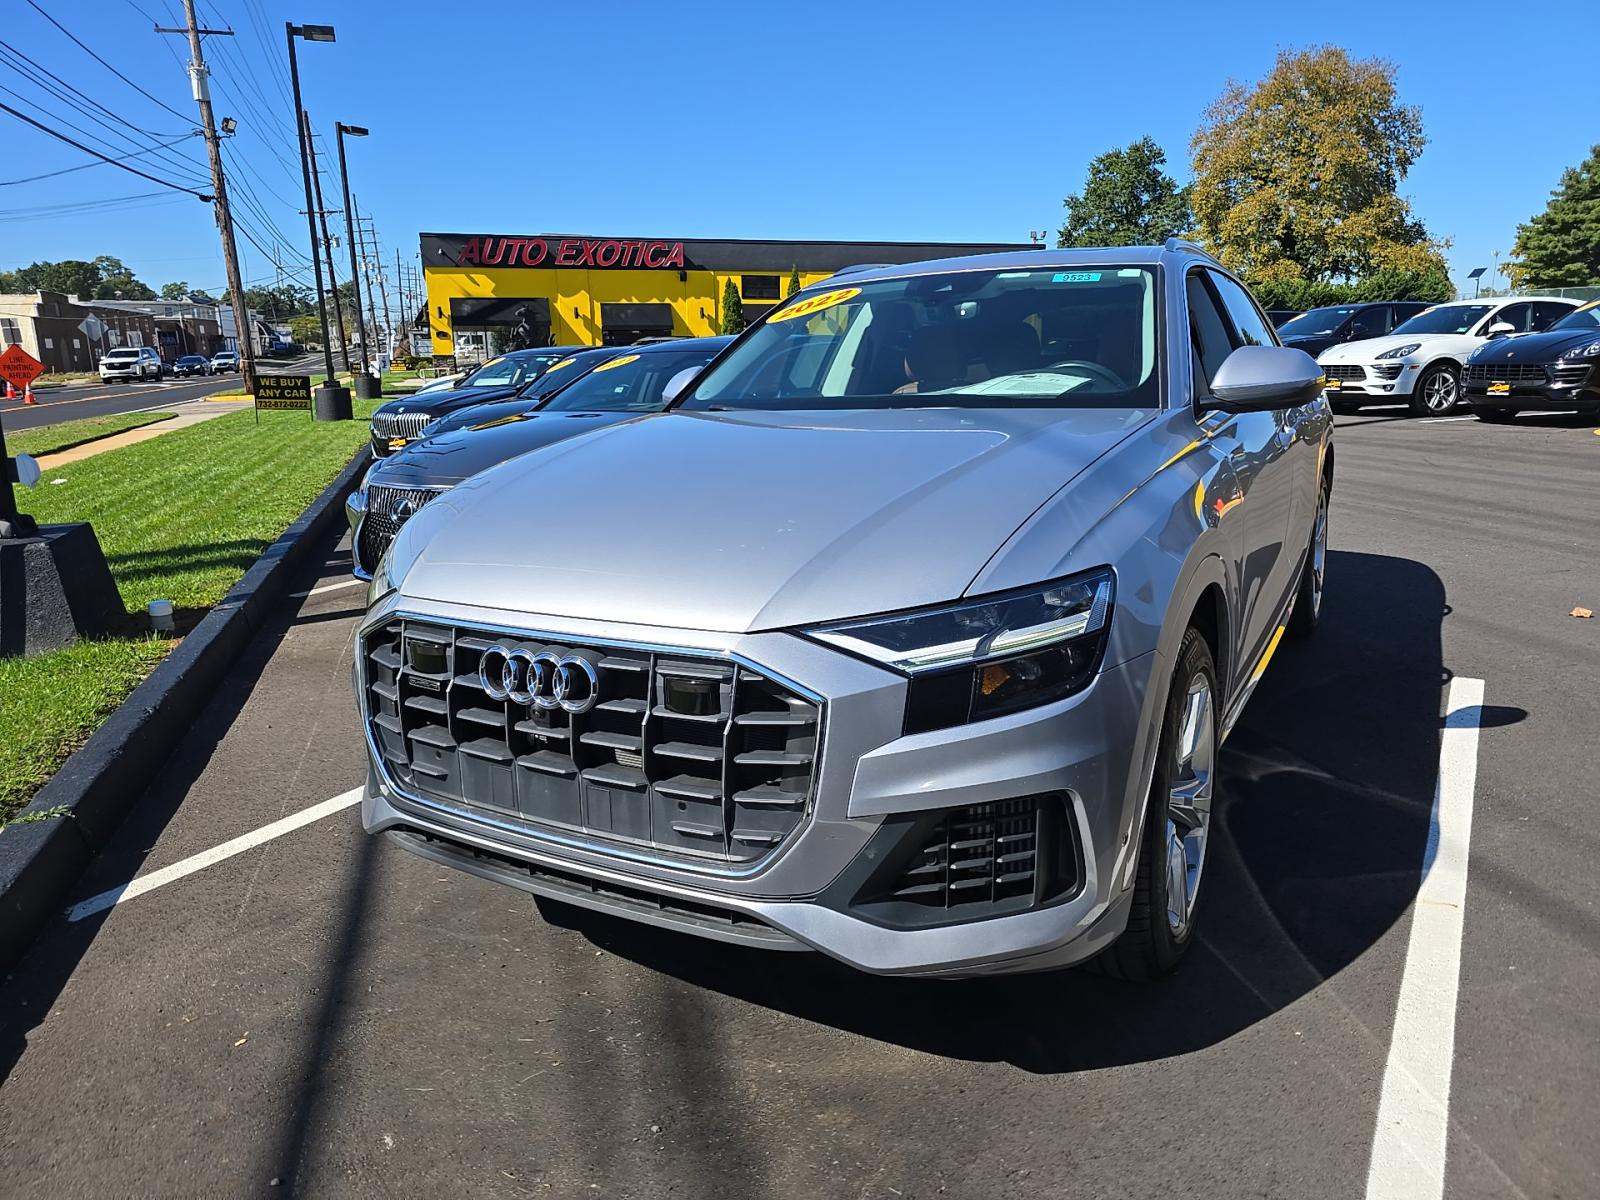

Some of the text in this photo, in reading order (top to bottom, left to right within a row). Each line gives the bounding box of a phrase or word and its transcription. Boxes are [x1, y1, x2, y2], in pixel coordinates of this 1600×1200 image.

[458, 238, 685, 268] AUTO EXOTICA
[774, 289, 853, 321] 2022
[260, 378, 302, 387] WE BUY
[258, 389, 307, 398] ANY CAR
